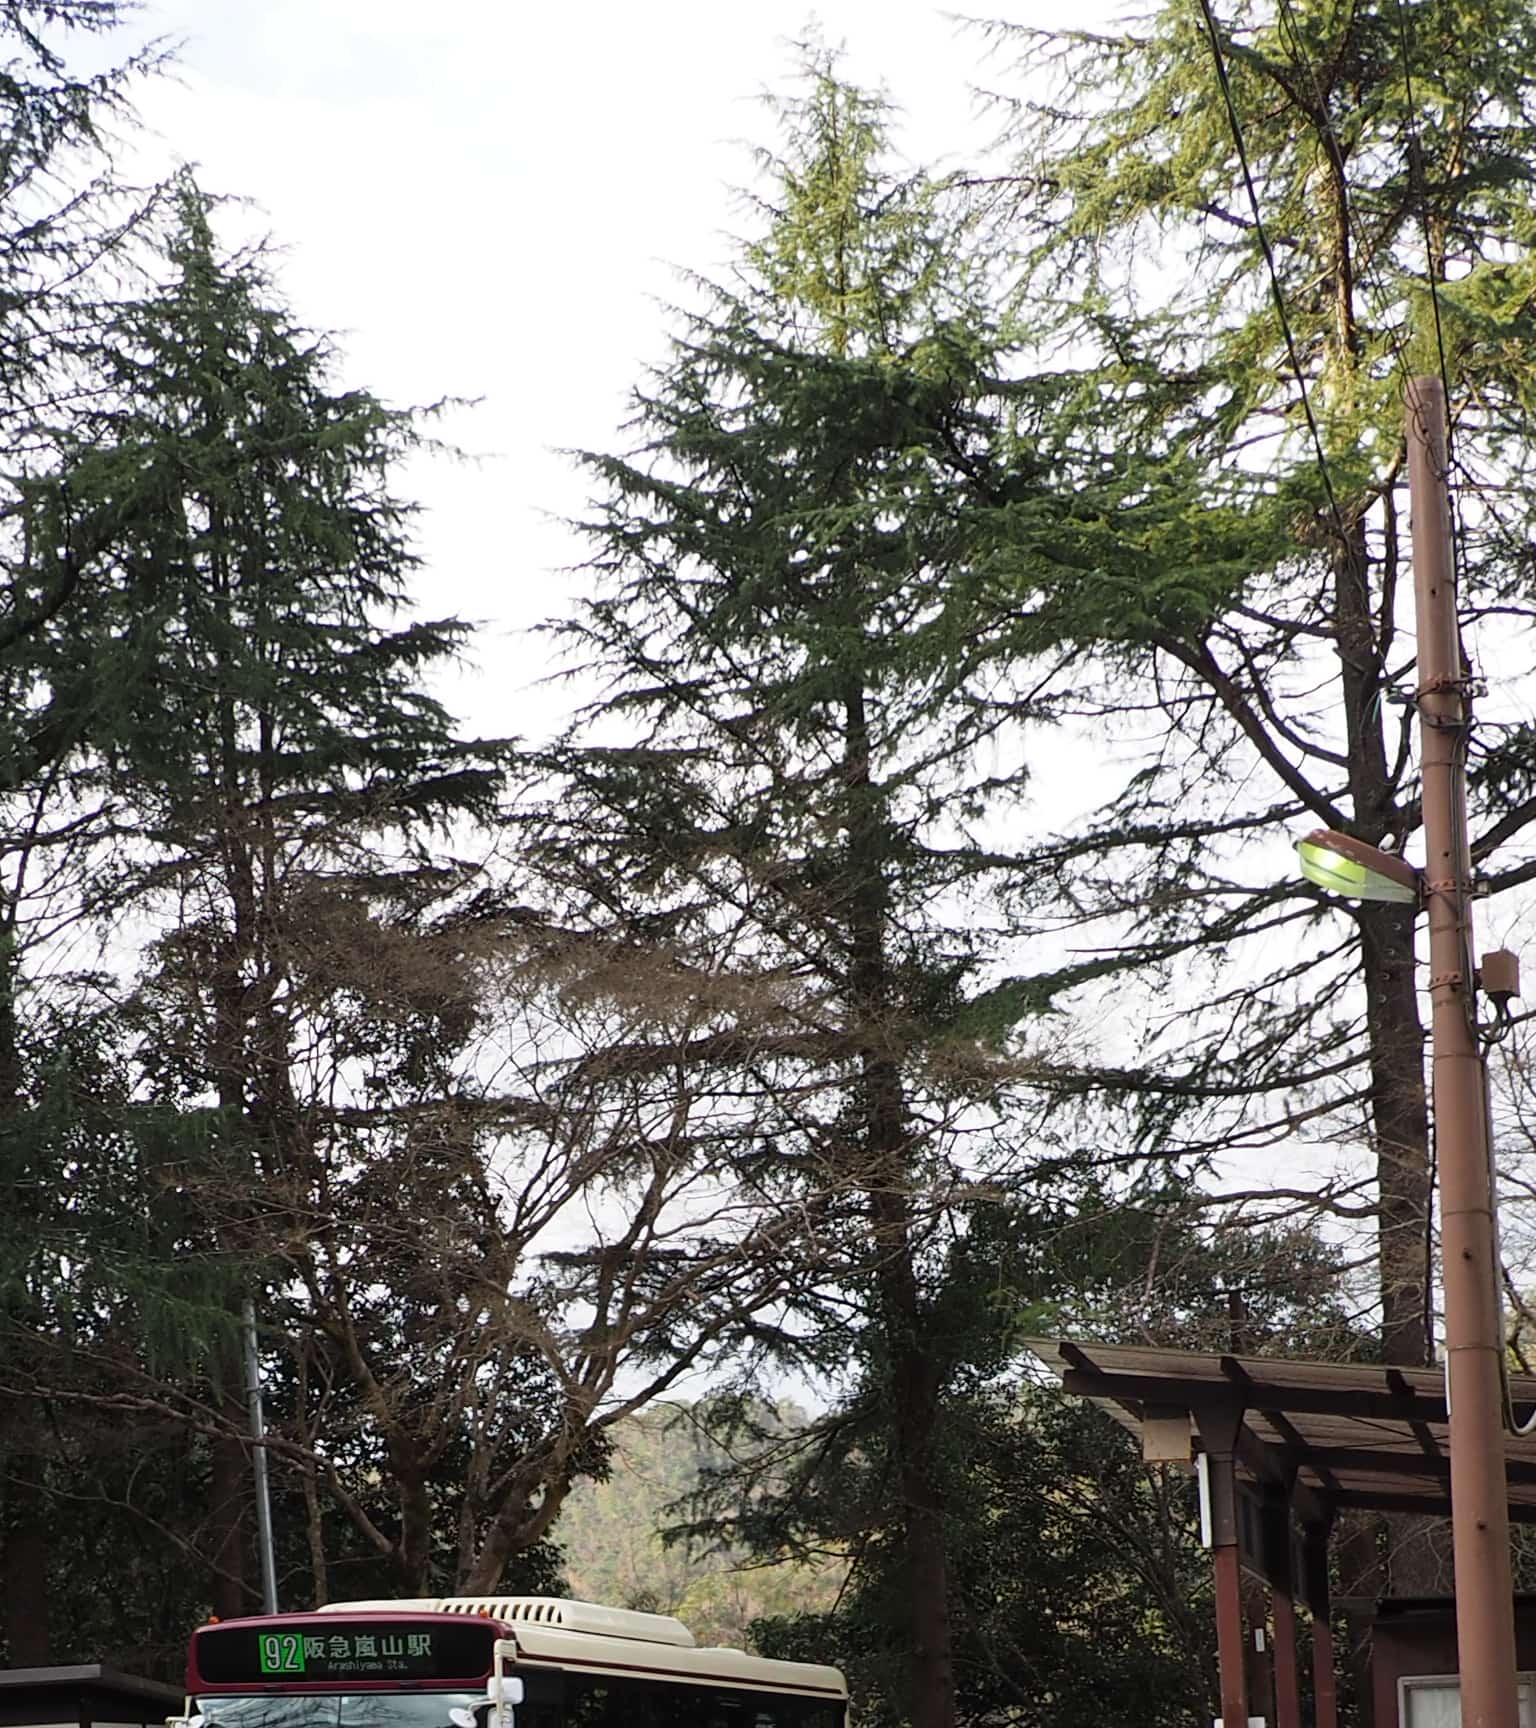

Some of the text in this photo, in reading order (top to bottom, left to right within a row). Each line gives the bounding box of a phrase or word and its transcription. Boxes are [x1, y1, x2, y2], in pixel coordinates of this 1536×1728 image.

[265, 1636, 299, 1670] 92
[303, 1633, 432, 1659] 阪急嵐山駅
[327, 1660, 383, 1671] Arashiyama
